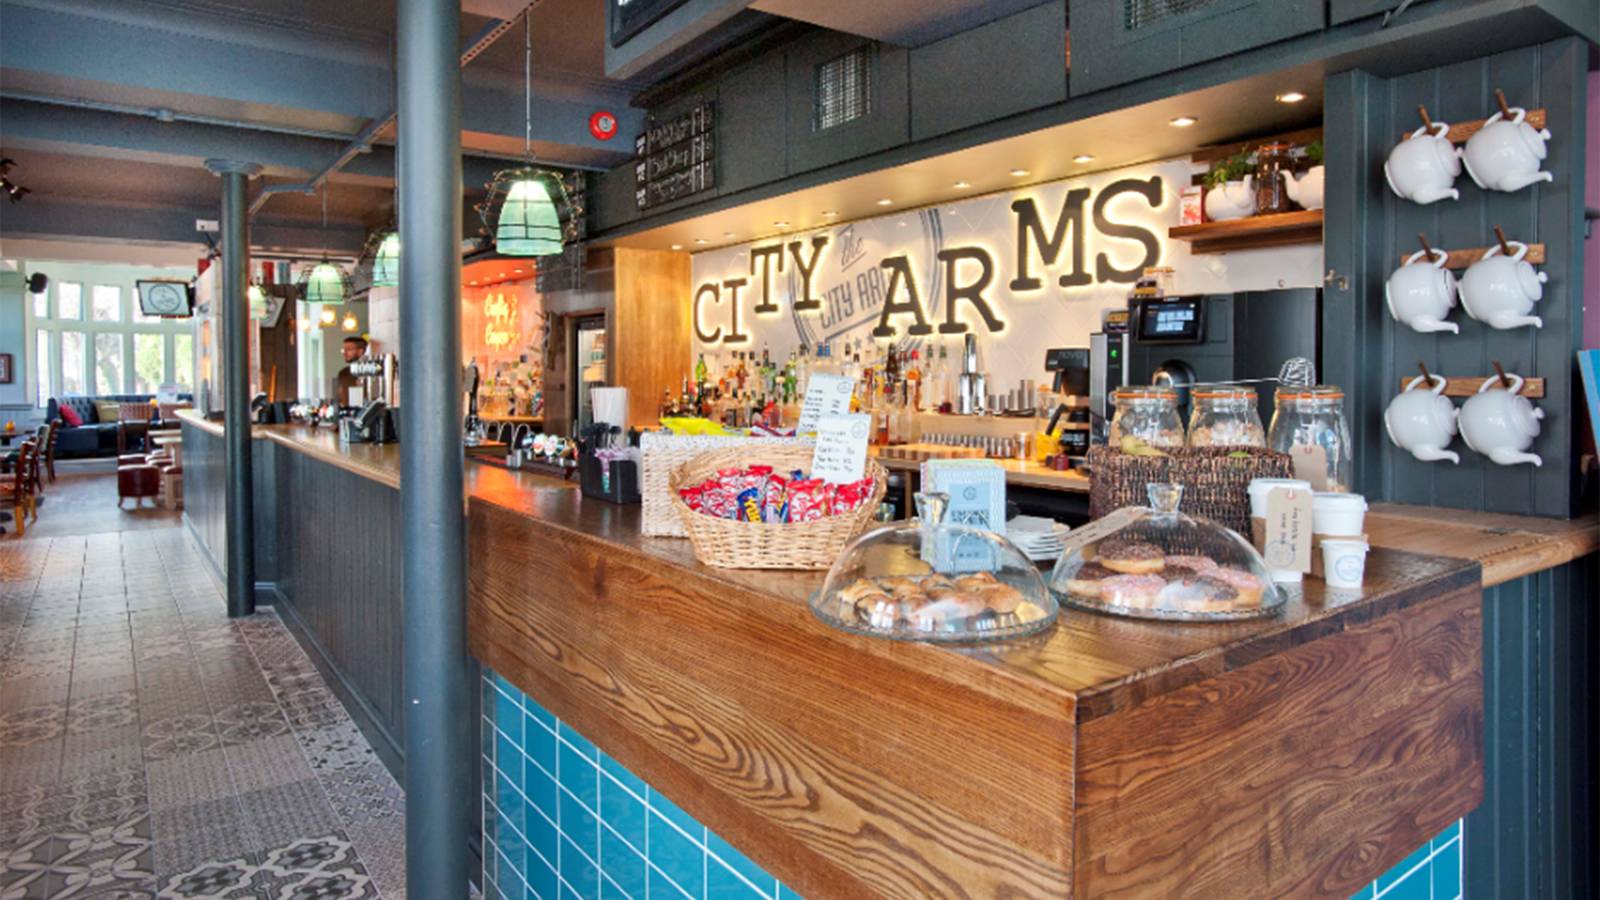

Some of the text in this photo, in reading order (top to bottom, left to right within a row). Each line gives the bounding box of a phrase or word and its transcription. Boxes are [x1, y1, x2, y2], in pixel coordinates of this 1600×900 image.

[693, 175, 1164, 344] CITY ARMS
[820, 281, 854, 329] CITY
